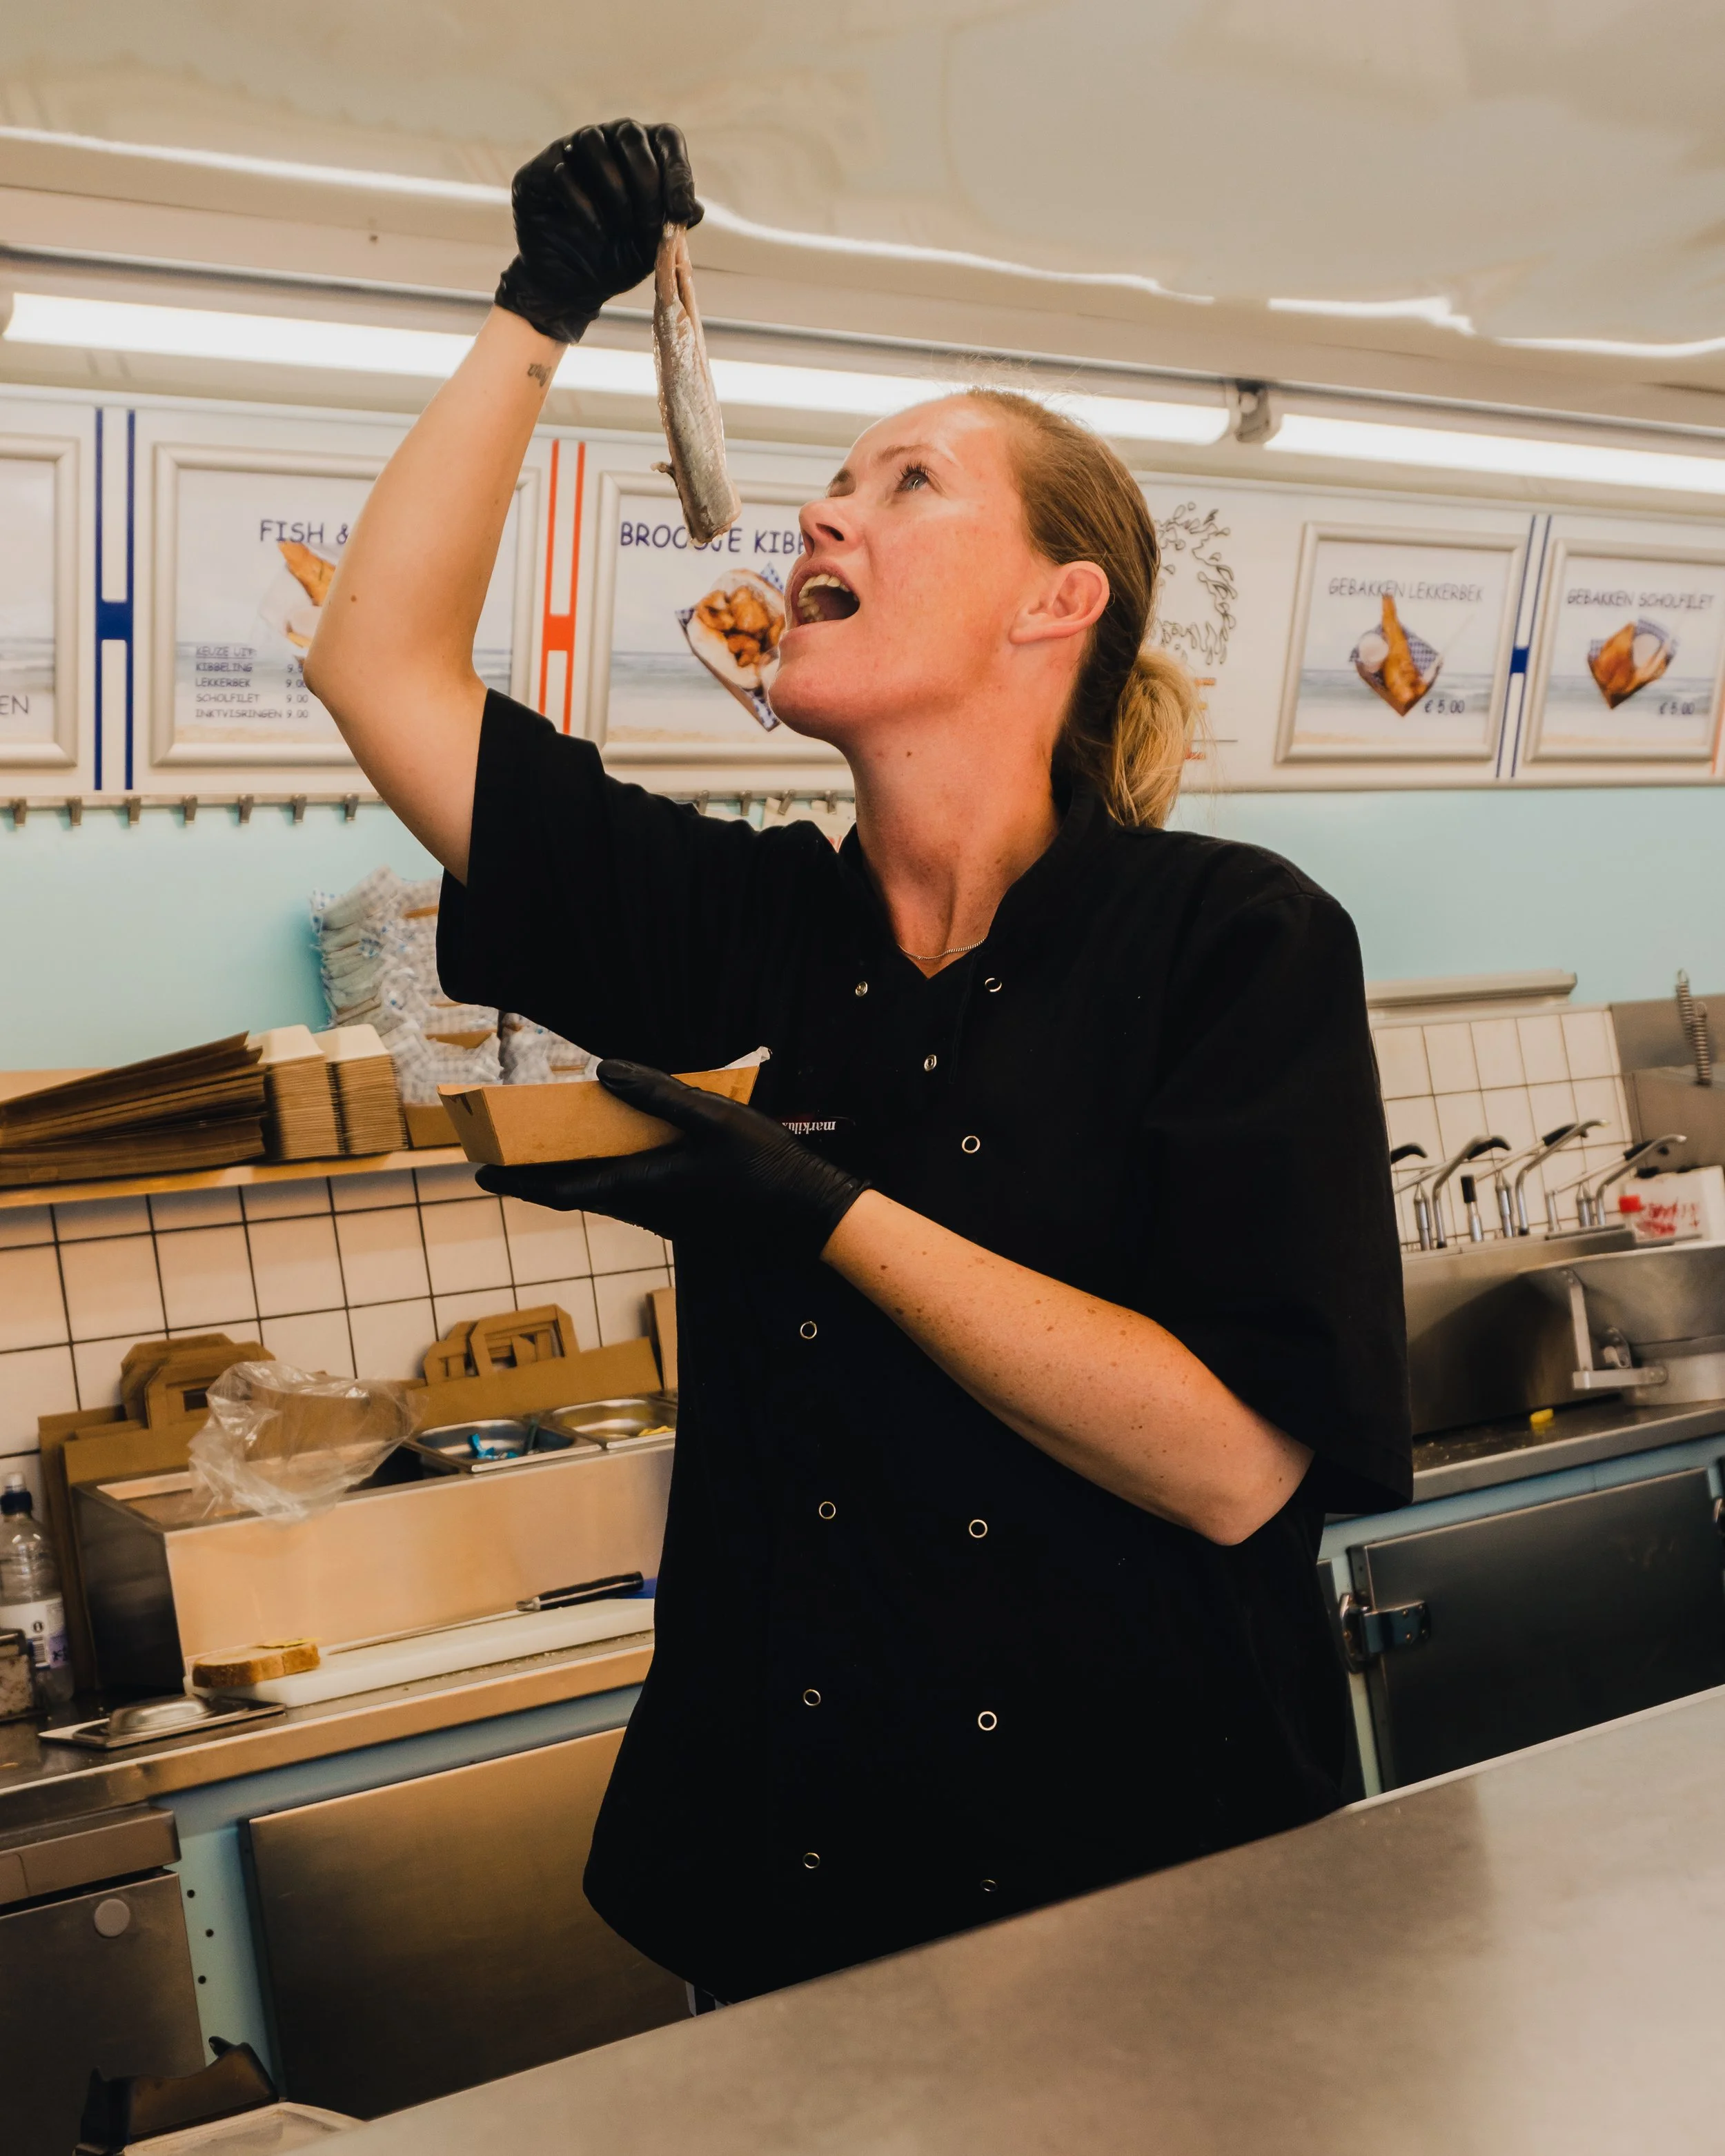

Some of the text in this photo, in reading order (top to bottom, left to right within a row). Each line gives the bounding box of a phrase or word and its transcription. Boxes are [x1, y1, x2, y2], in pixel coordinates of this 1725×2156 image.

[259, 519, 349, 545] FISH &
[1328, 577, 1483, 602] GEBAKKEN LEKKERBEK
[1567, 589, 1715, 610] GEBAKKEN SCHOLFILET
[196, 646, 229, 656] KEUZE
[196, 662, 253, 673] KIBBELING
[195, 678, 251, 688] LEKKERBEK
[196, 693, 260, 703] SCHOLFILET
[1424, 699, 1433, 713] €
[195, 709, 282, 719] INKTVISRINGEN
